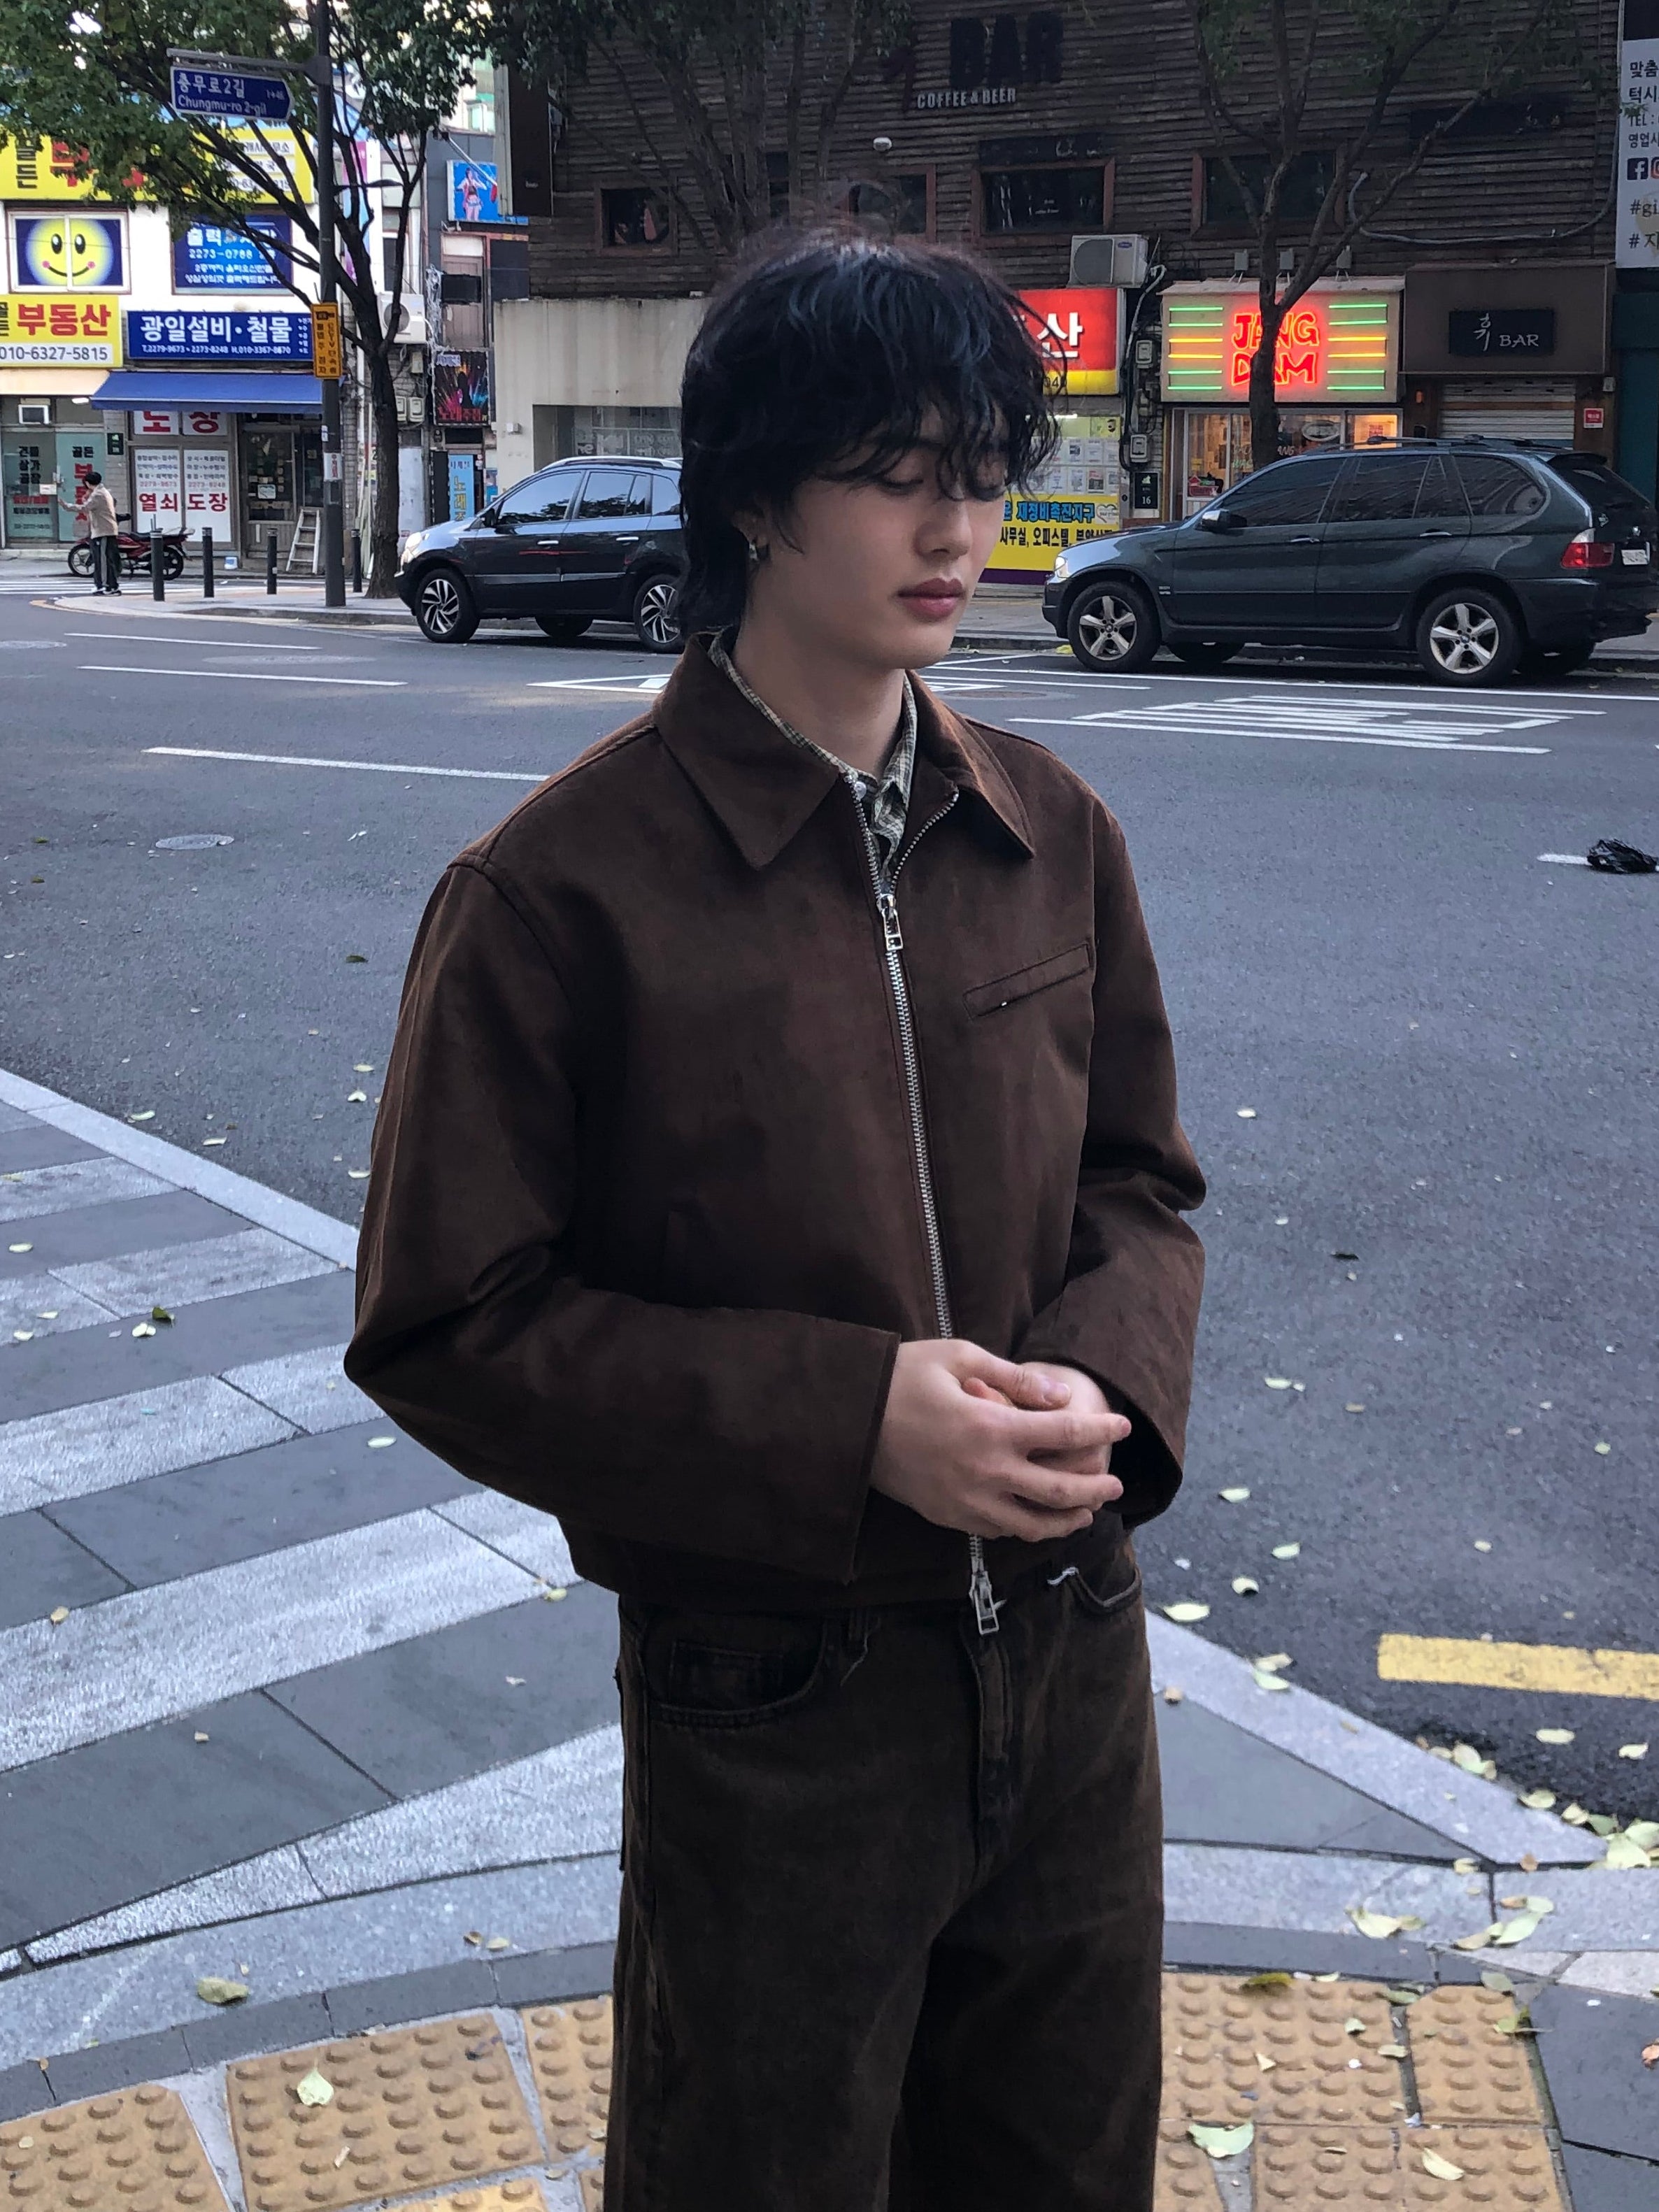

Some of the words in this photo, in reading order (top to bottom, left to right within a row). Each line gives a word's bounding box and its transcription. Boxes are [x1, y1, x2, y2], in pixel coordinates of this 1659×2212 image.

[177, 72, 245, 99] 충무로2길
[1629, 85, 1659, 104] 턱시
[178, 94, 242, 113] Chungmu-ro
[244, 101, 266, 117] 2-gil
[917, 91, 967, 109] COFFEE
[971, 90, 978, 104] &
[983, 88, 1016, 105] BEER
[17, 304, 112, 336] 부동산
[1499, 334, 1539, 348] BAR
[0, 346, 108, 360] 010-6327-5815
[1231, 351, 1317, 386] DM
[139, 492, 178, 513] 열쇠
[187, 492, 228, 513] 도장
[1141, 496, 1151, 505] 16
[1016, 501, 1095, 523] 재정비촉진지구
